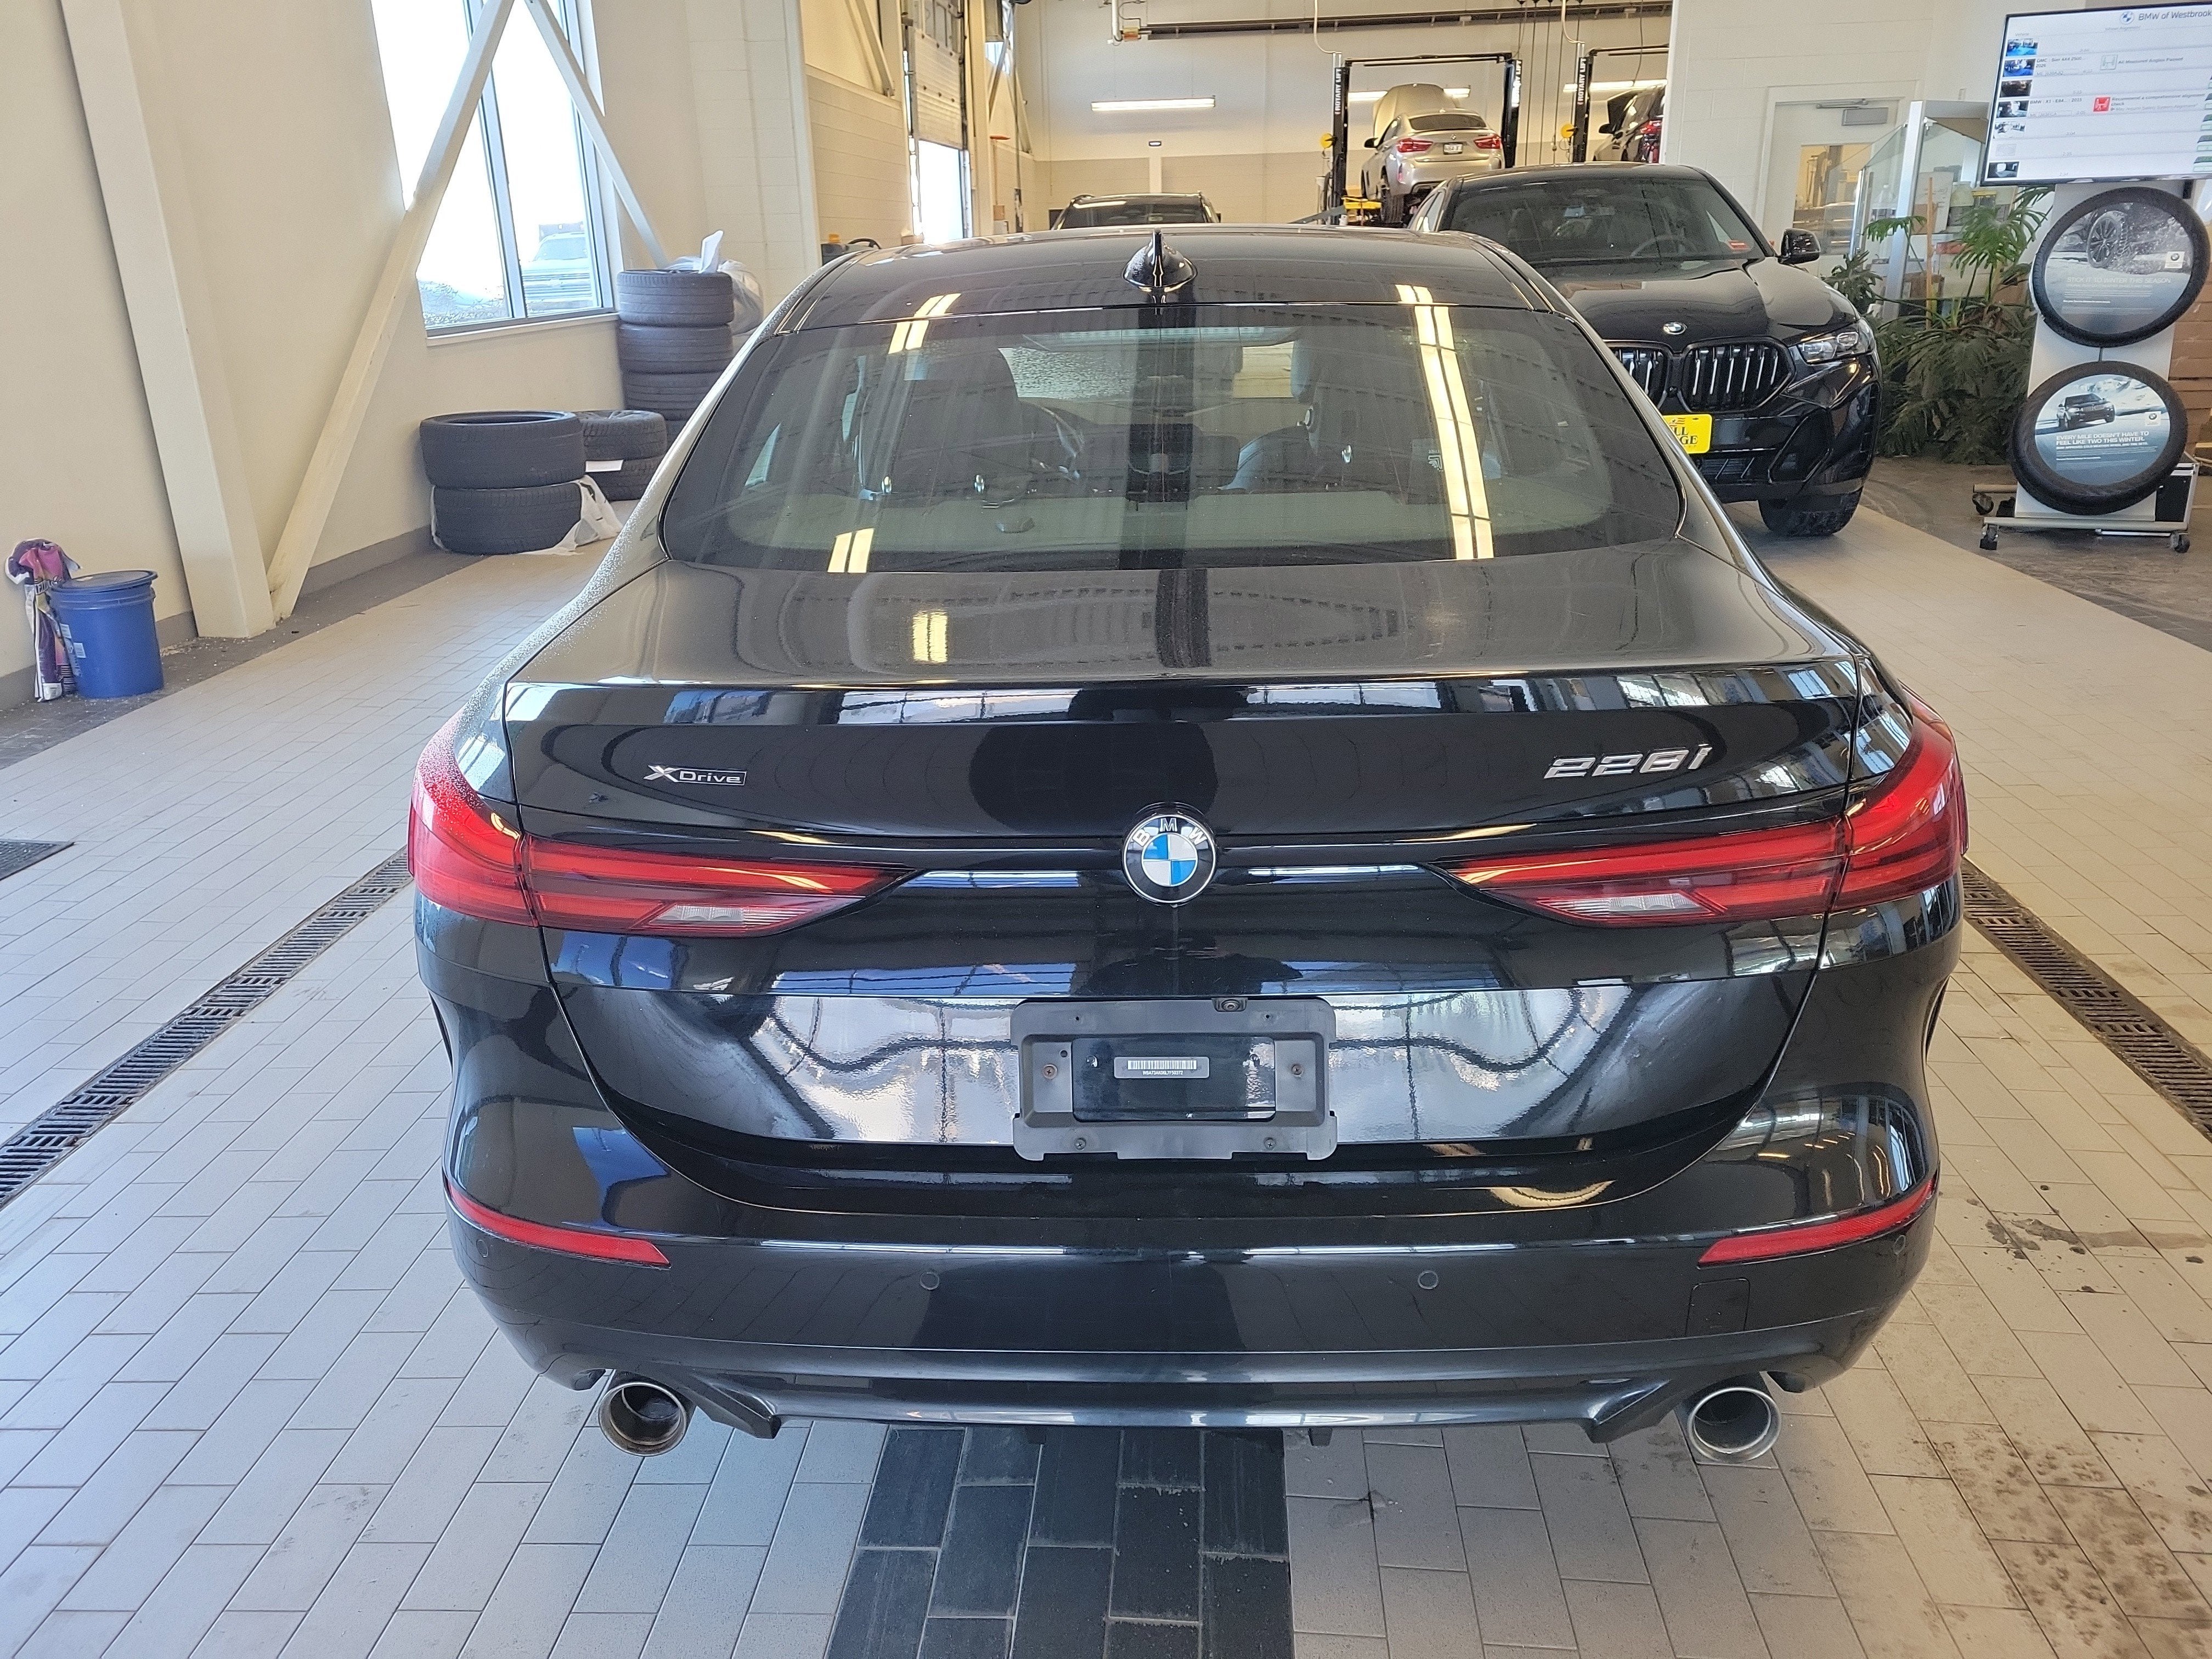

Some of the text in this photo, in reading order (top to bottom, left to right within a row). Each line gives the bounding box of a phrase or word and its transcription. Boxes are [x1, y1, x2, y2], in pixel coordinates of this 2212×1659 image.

[2171, 9, 2212, 19] Westbrook
[1577, 74, 1585, 101] ROTARY
[1544, 743, 1713, 779] 228i
[1132, 817, 1208, 847] BMW
